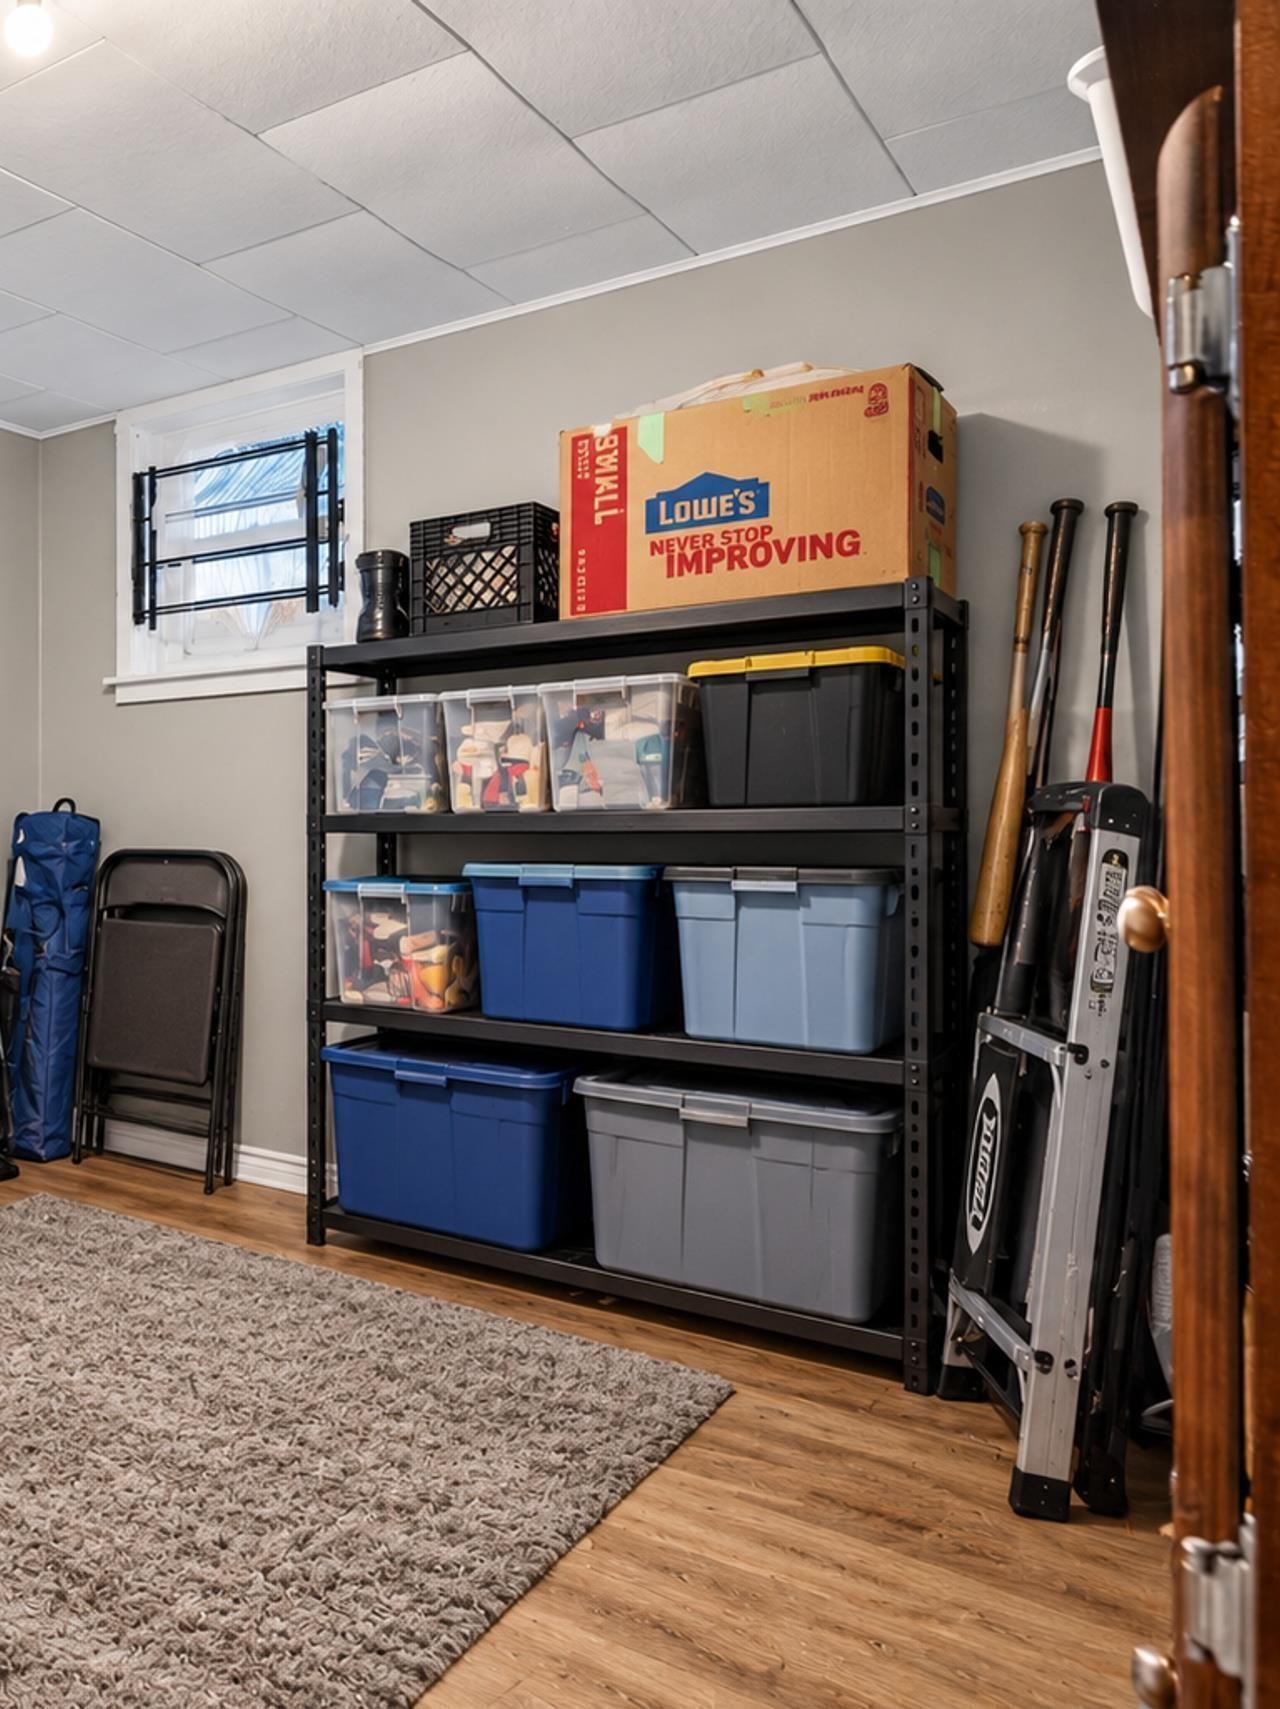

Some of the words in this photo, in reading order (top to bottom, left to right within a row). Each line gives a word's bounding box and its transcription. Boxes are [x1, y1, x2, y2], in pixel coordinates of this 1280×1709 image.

[659, 488, 756, 526] LOWE'S
[650, 533, 714, 556] NEVER
[721, 525, 773, 546] STOP
[666, 529, 861, 578] IMPROVING
